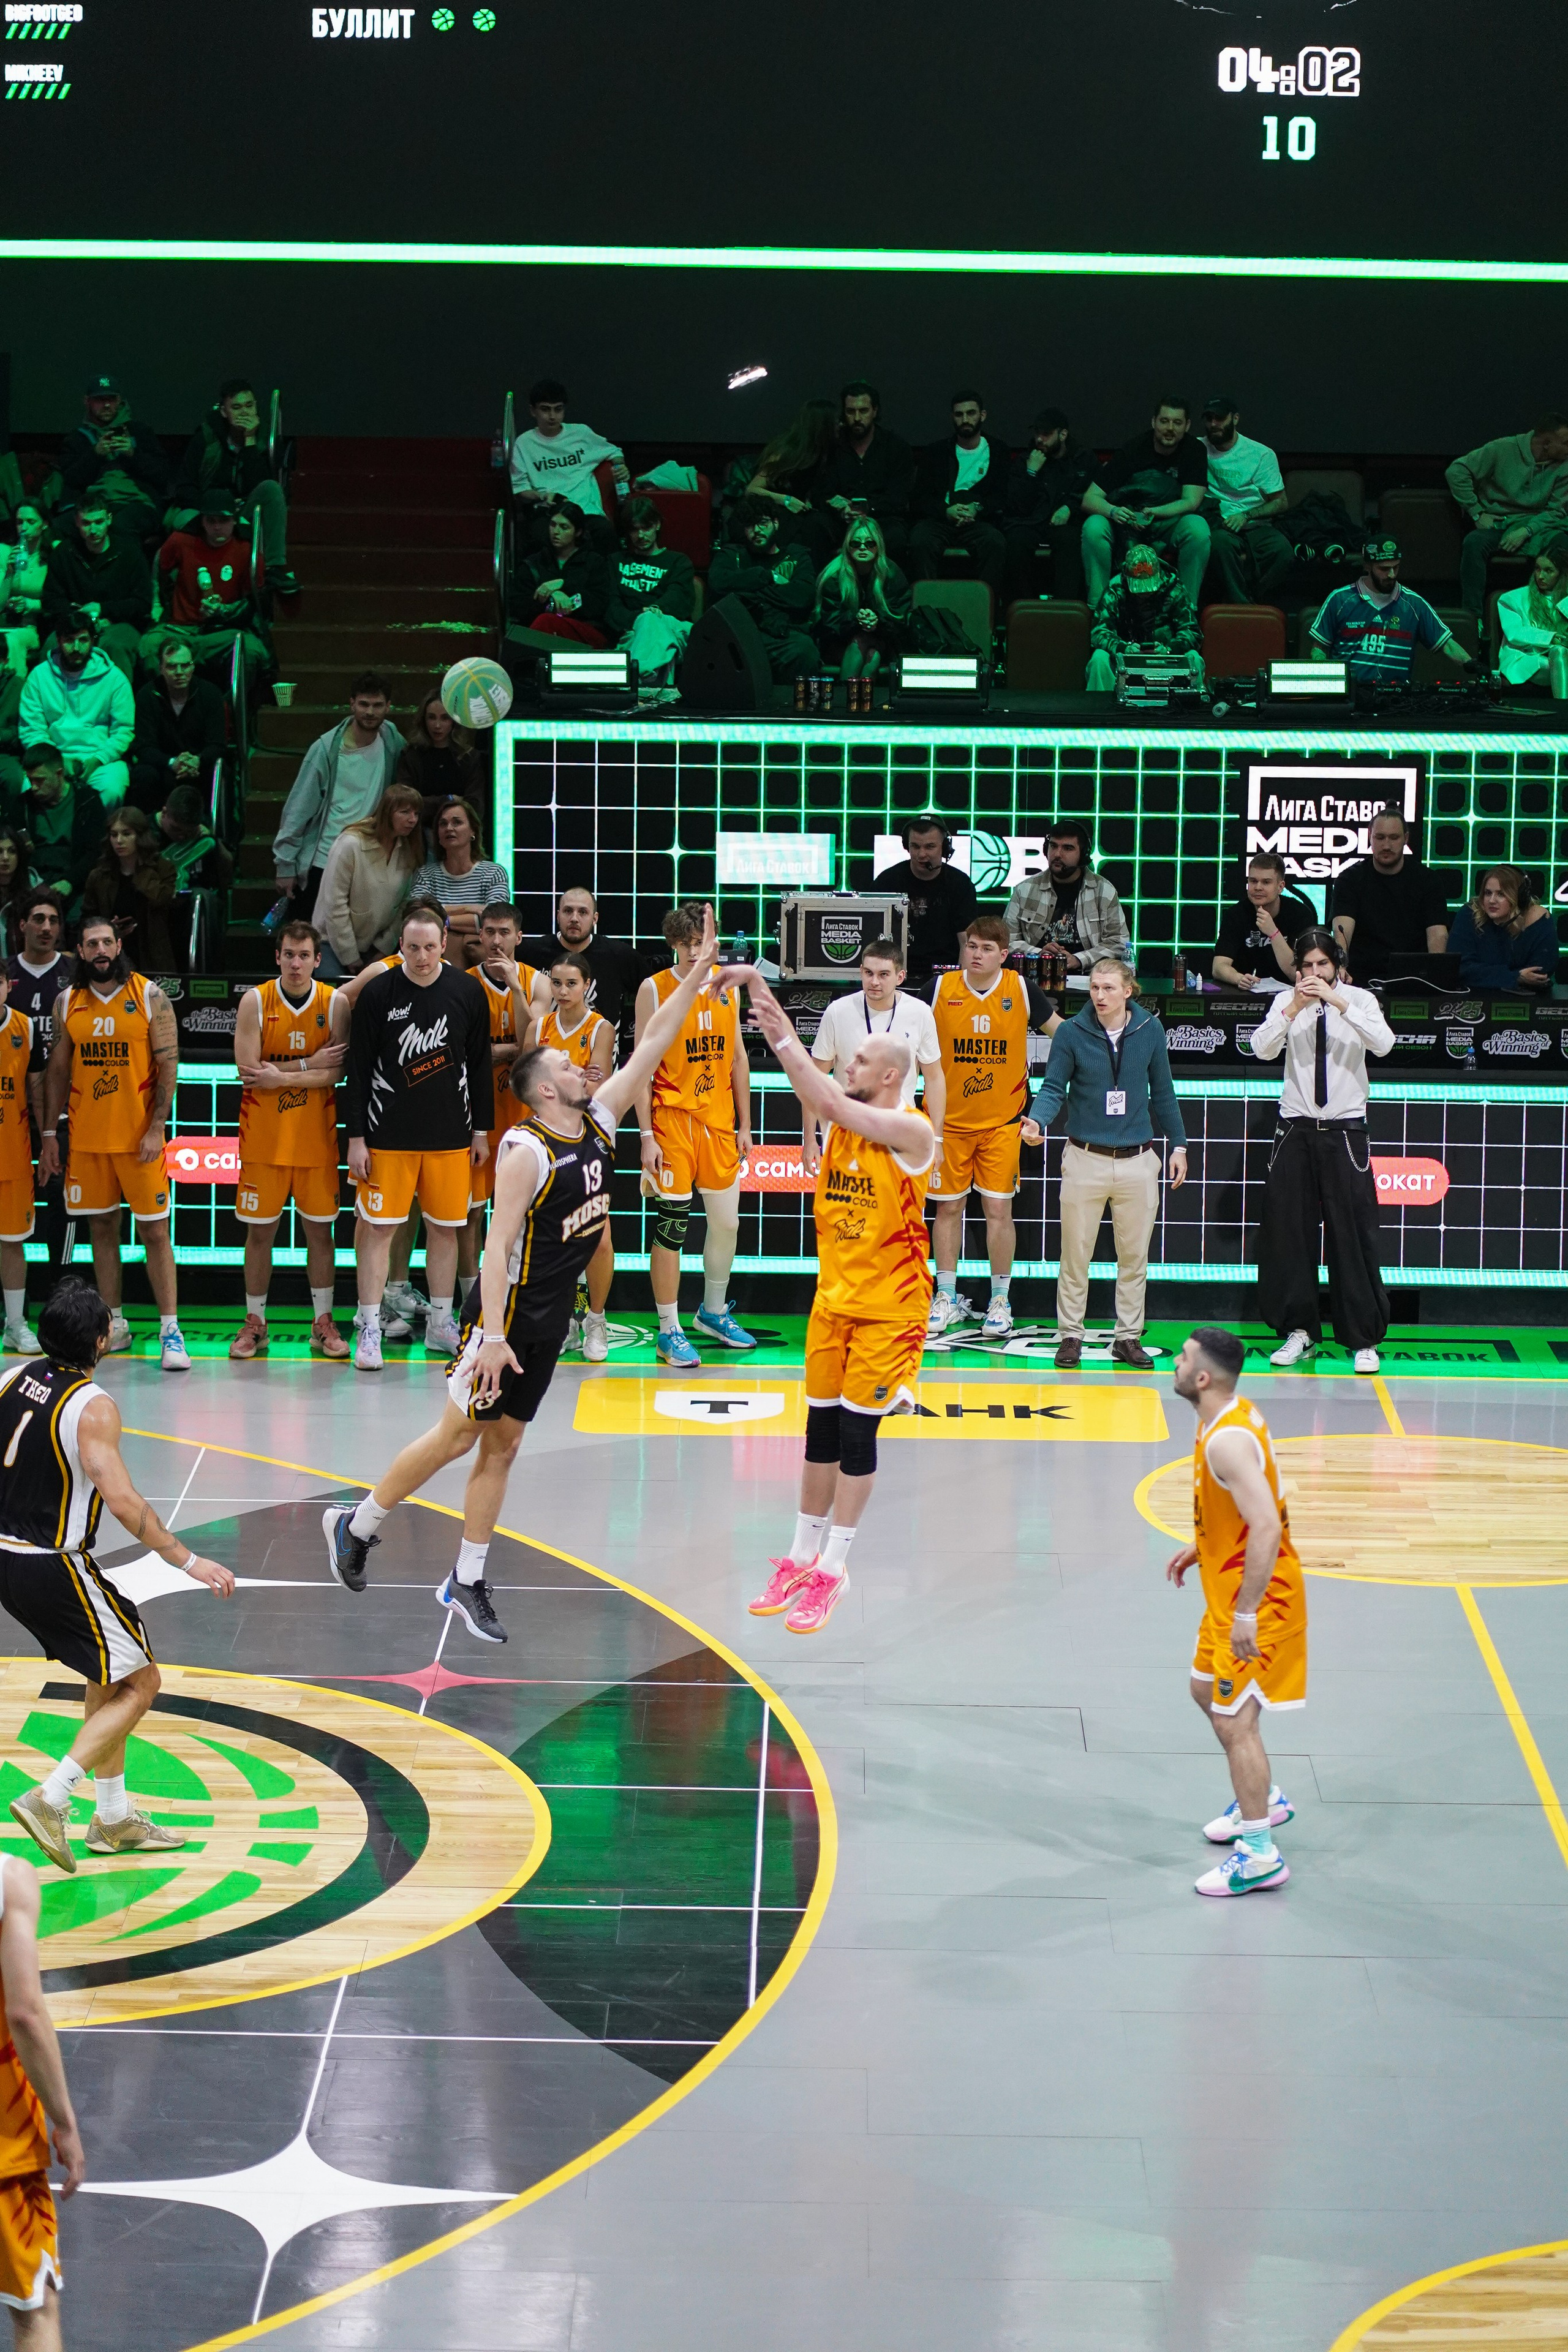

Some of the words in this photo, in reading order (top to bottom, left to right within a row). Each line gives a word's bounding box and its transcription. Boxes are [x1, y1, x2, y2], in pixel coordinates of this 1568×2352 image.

[311, 8, 415, 39] БУЛЛИТ
[1218, 47, 1360, 97] 04:02
[1262, 116, 1316, 160] 10
[1360, 633, 1386, 654] 495
[1321, 795, 1401, 822] СТАВО
[1245, 856, 1365, 878] ASK
[31, 992, 41, 1011] 4
[202, 1007, 238, 1021] Basi
[698, 1010, 712, 1031] 10
[971, 1014, 990, 1034] 16
[92, 1016, 115, 1037] 20
[1177, 1026, 1223, 1039] Basics
[1502, 1030, 1548, 1044] Basics
[80, 1042, 130, 1058] MASTER
[288, 1030, 306, 1050] 15
[953, 1038, 1008, 1055] MASTER
[1483, 1040, 1539, 1055] Winning
[412, 1062, 432, 1076] SINCE
[432, 1055, 445, 1066] 2011
[694, 1072, 715, 1097] Md
[582, 1159, 603, 1195] 13
[827, 1168, 876, 1197] MASTE
[1373, 1174, 1436, 1190] окат
[67, 1185, 82, 1204] 0
[240, 1191, 259, 1212] 15
[852, 1196, 879, 1209] COLO
[562, 1193, 610, 1244] MOSC
[1385, 1351, 1489, 1363] ТАВОК
[18, 1375, 52, 1405] THEO
[886, 1404, 1076, 1420] АНК
[3, 1410, 34, 1467] 1
